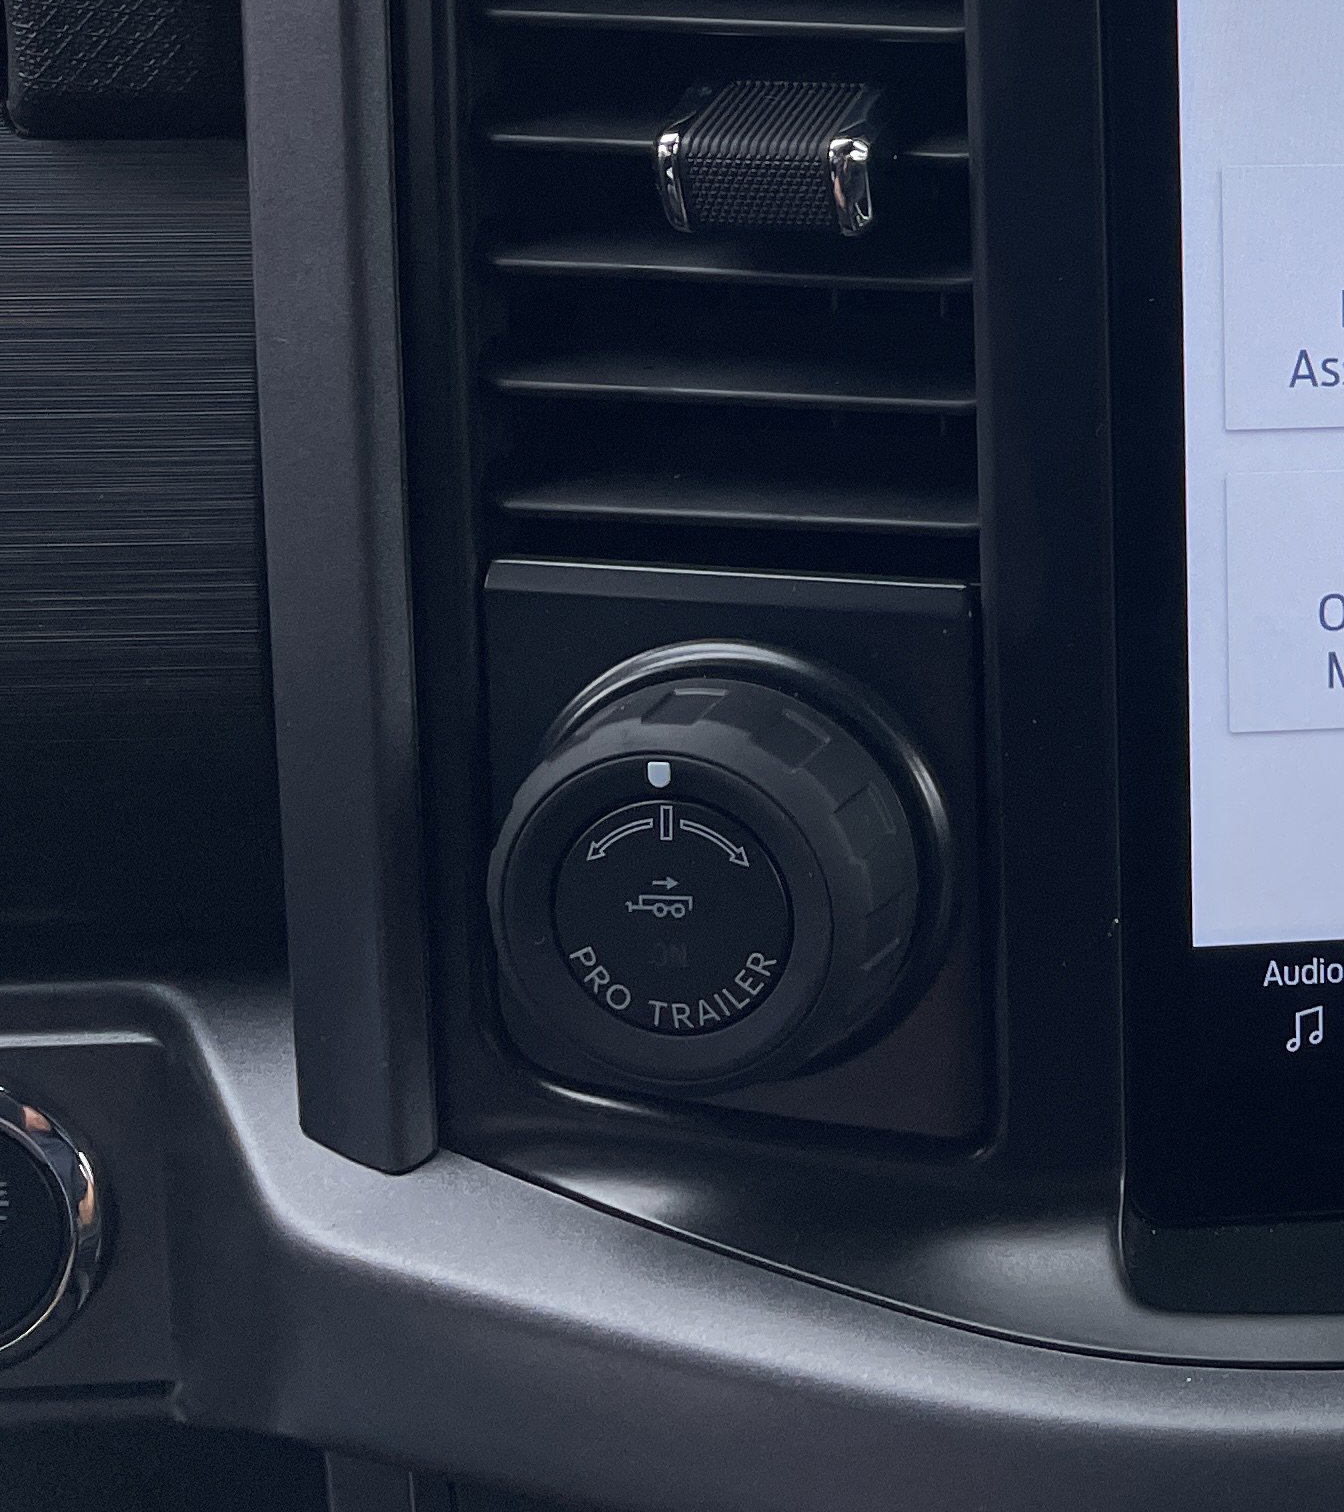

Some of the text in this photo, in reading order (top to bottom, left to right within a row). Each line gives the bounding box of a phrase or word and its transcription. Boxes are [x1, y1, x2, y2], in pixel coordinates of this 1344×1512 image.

[568, 945, 777, 1029] PRO TRAILER
[1263, 957, 1344, 987] Audio
